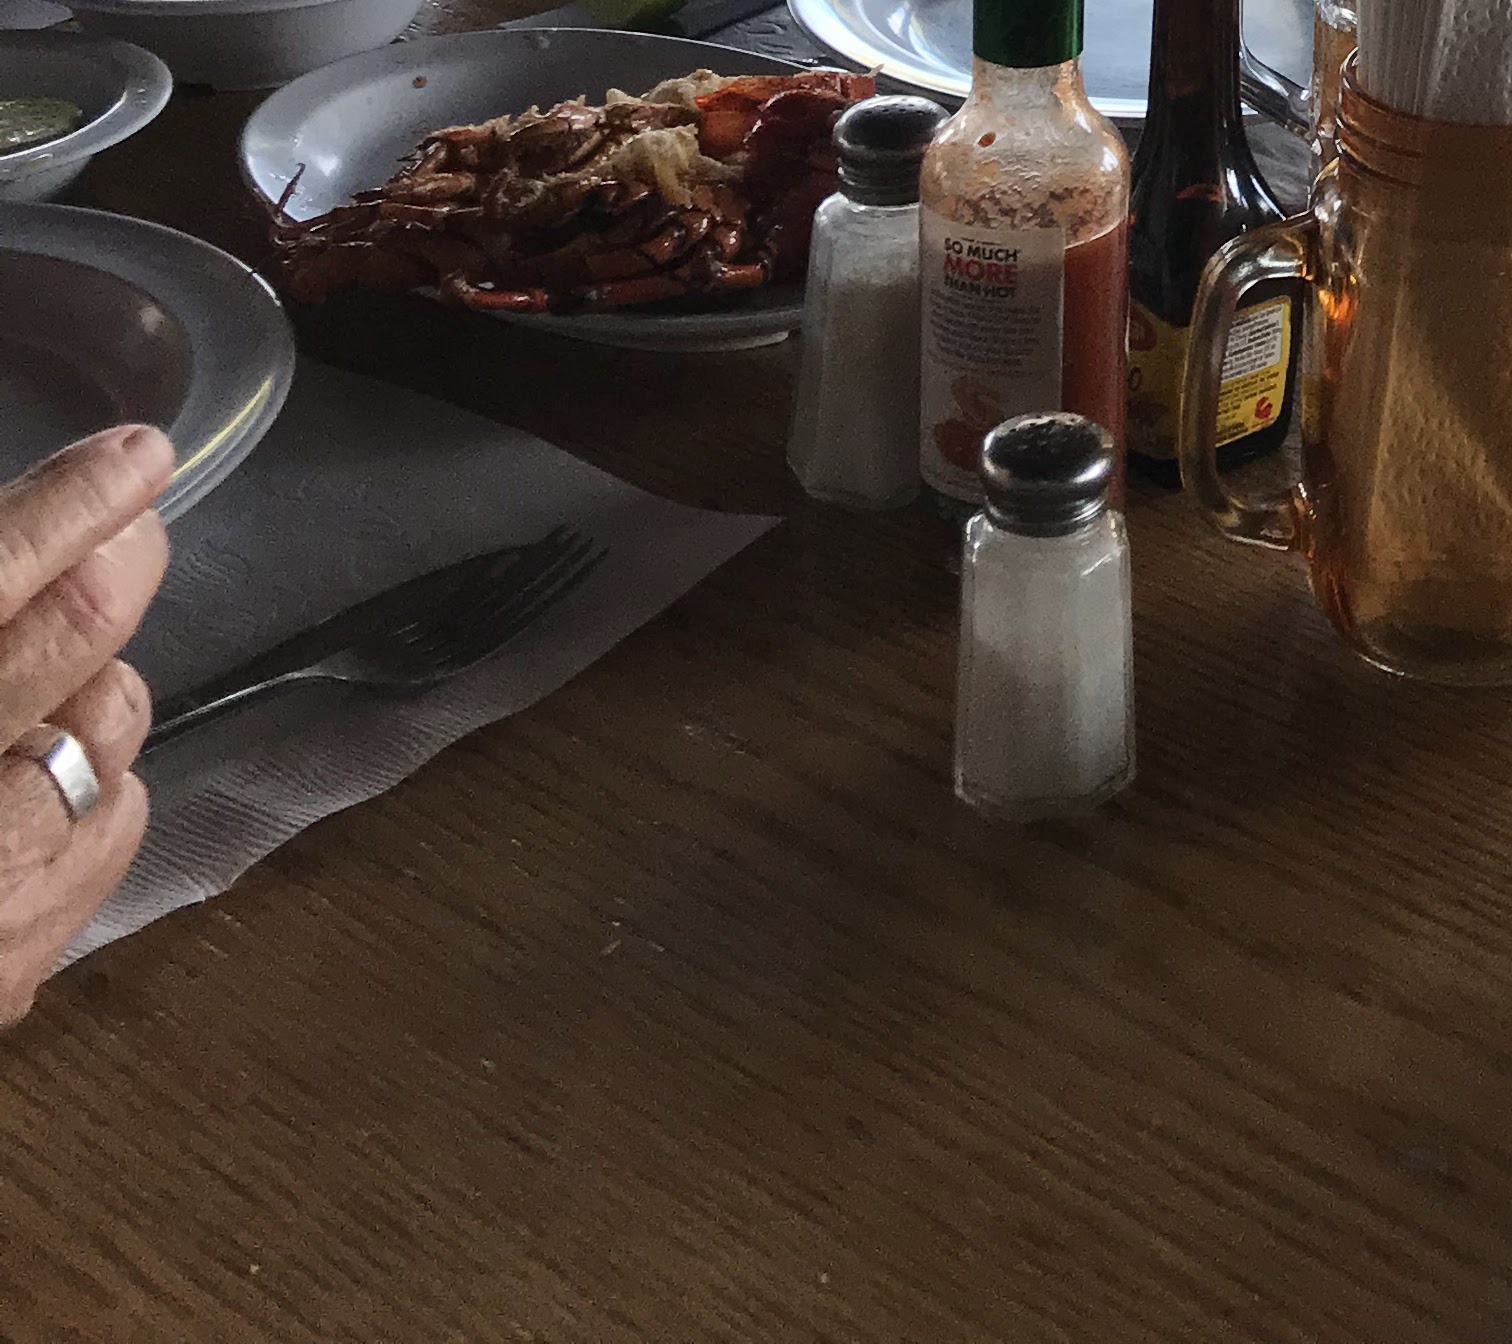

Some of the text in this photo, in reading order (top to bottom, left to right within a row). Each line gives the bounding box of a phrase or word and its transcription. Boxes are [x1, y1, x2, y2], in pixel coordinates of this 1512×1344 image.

[944, 238, 1018, 262] SO MUCH
[943, 255, 1018, 285] MORE
[943, 274, 1017, 299] THAN HOT
